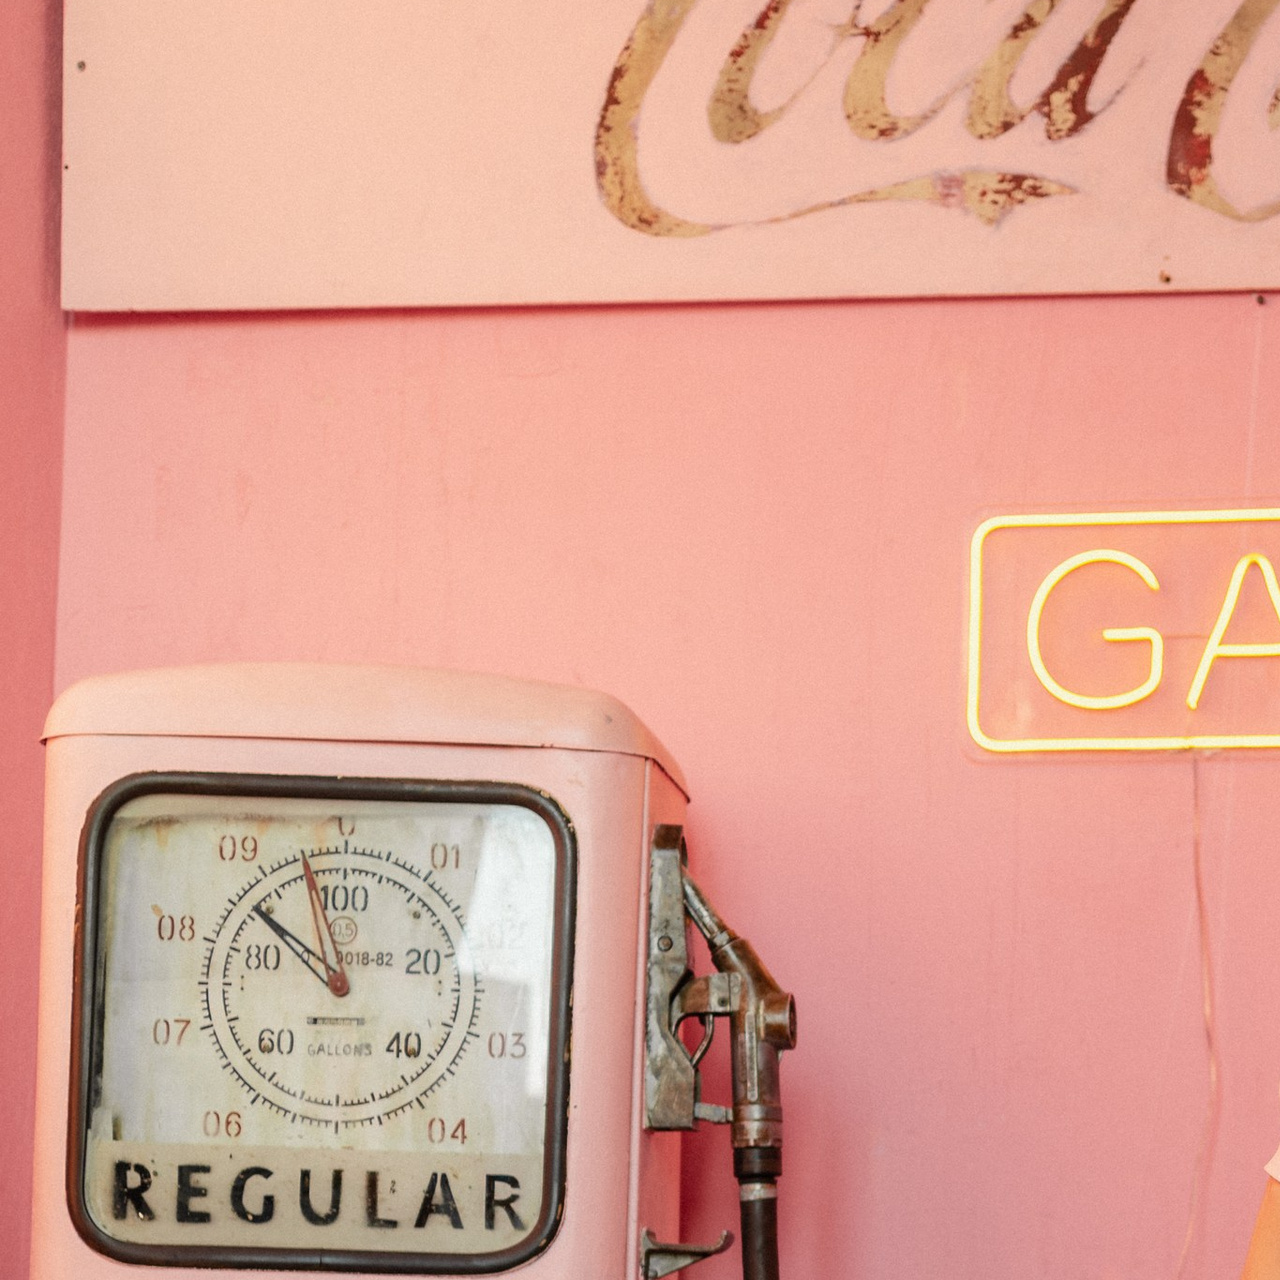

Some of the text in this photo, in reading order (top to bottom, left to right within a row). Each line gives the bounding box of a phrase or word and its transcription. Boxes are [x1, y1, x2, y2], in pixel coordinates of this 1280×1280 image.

[218, 835, 258, 862] 09
[430, 843, 460, 870] 01
[320, 885, 369, 912] 100
[157, 914, 196, 942] 08
[245, 944, 281, 971] 80
[405, 948, 441, 975] 20
[152, 1018, 191, 1047] 07
[257, 1028, 295, 1056] 60
[386, 1031, 422, 1059] 40
[487, 1031, 528, 1060] 03
[307, 1042, 372, 1057] GALLONS
[202, 1111, 243, 1139] 06
[428, 1117, 469, 1146] 04
[111, 1160, 529, 1233] REGULAR
